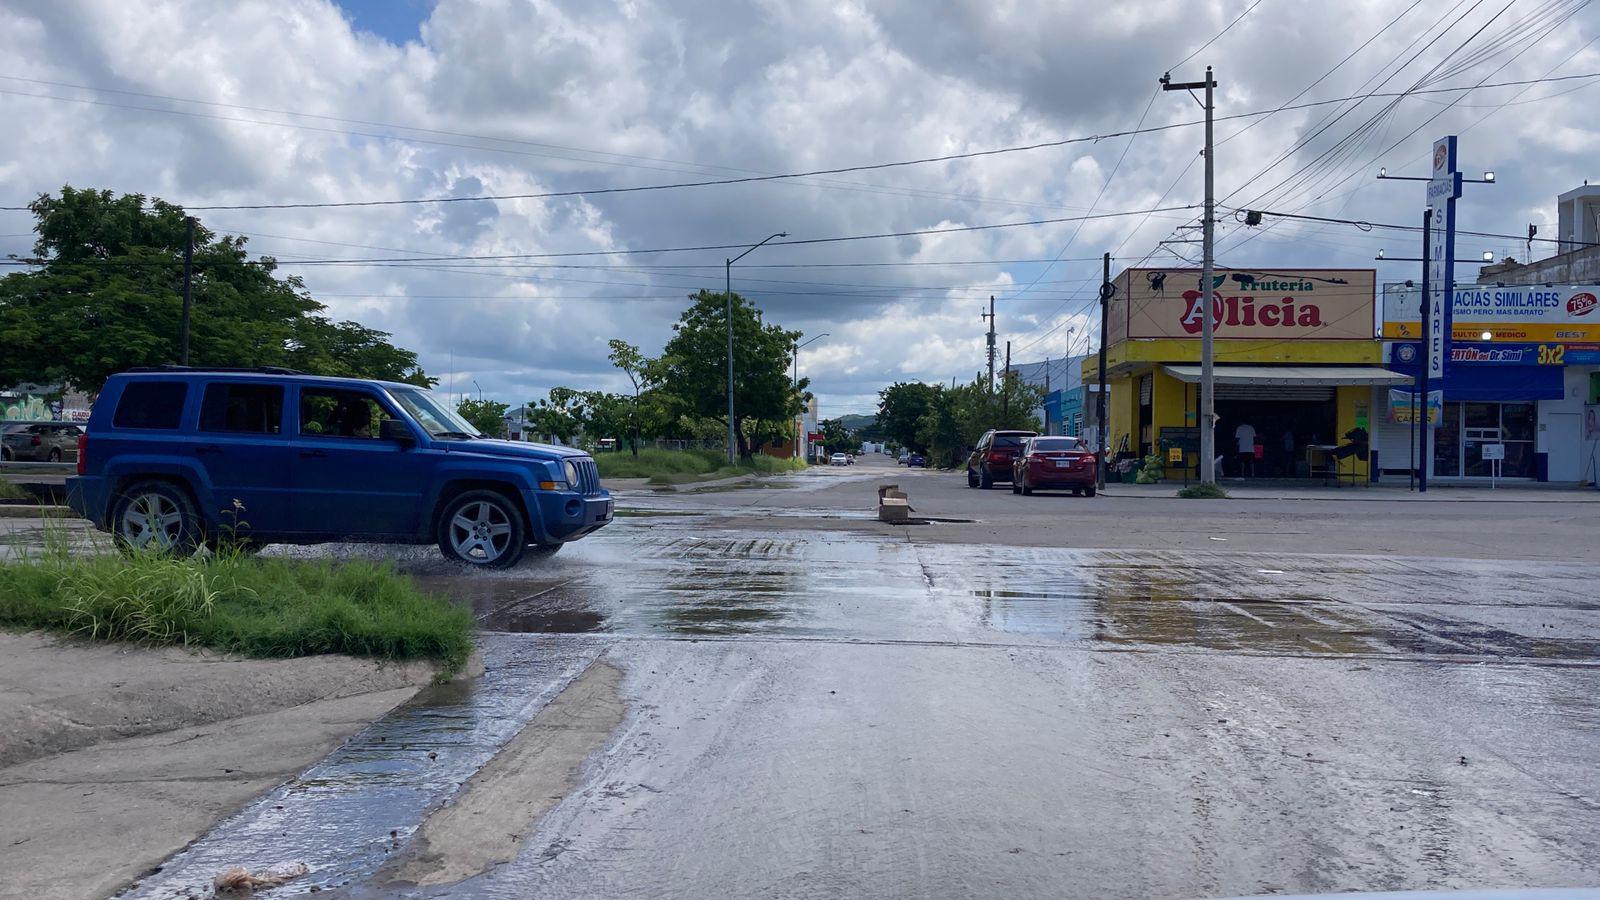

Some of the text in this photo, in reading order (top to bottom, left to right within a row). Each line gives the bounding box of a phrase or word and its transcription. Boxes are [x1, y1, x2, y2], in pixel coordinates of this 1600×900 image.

[1239, 279, 1314, 291] Frutería
[1432, 209, 1443, 371] SIMILARES
[1454, 291, 1559, 307] ACIAS SIMILARES
[1570, 296, 1593, 311] 75%
[1180, 290, 1322, 334] Alicia
[1473, 308, 1494, 316] PERO
[1451, 348, 1479, 360] ERTÓN
[1501, 350, 1522, 360] Simi
